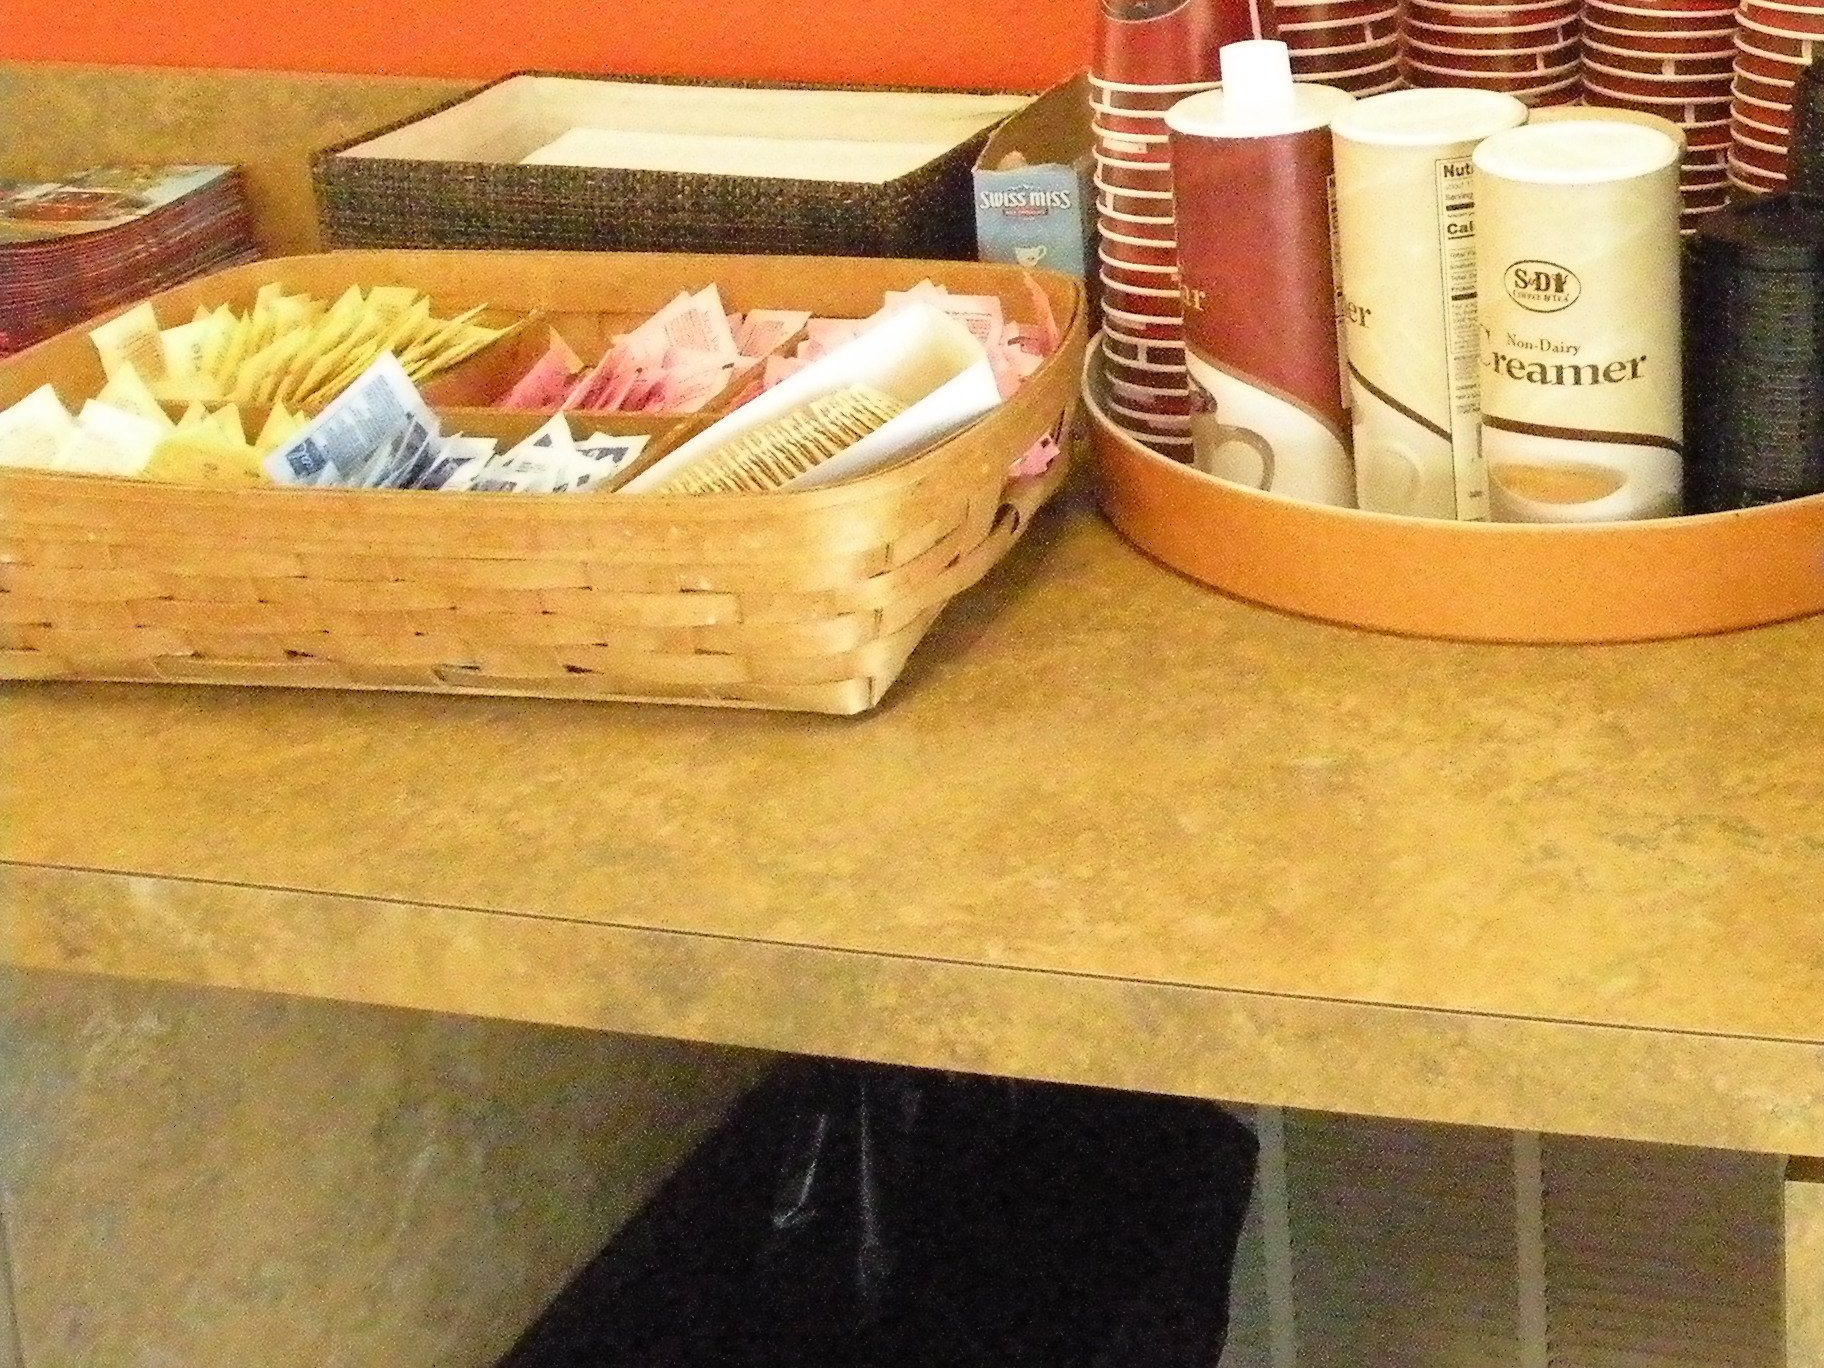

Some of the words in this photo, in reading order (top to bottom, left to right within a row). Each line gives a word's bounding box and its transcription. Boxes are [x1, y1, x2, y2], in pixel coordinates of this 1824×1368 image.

[980, 191, 1027, 209] SWISS
[1030, 191, 1071, 209] MISS
[1507, 332, 1582, 357] Non-Dairy
